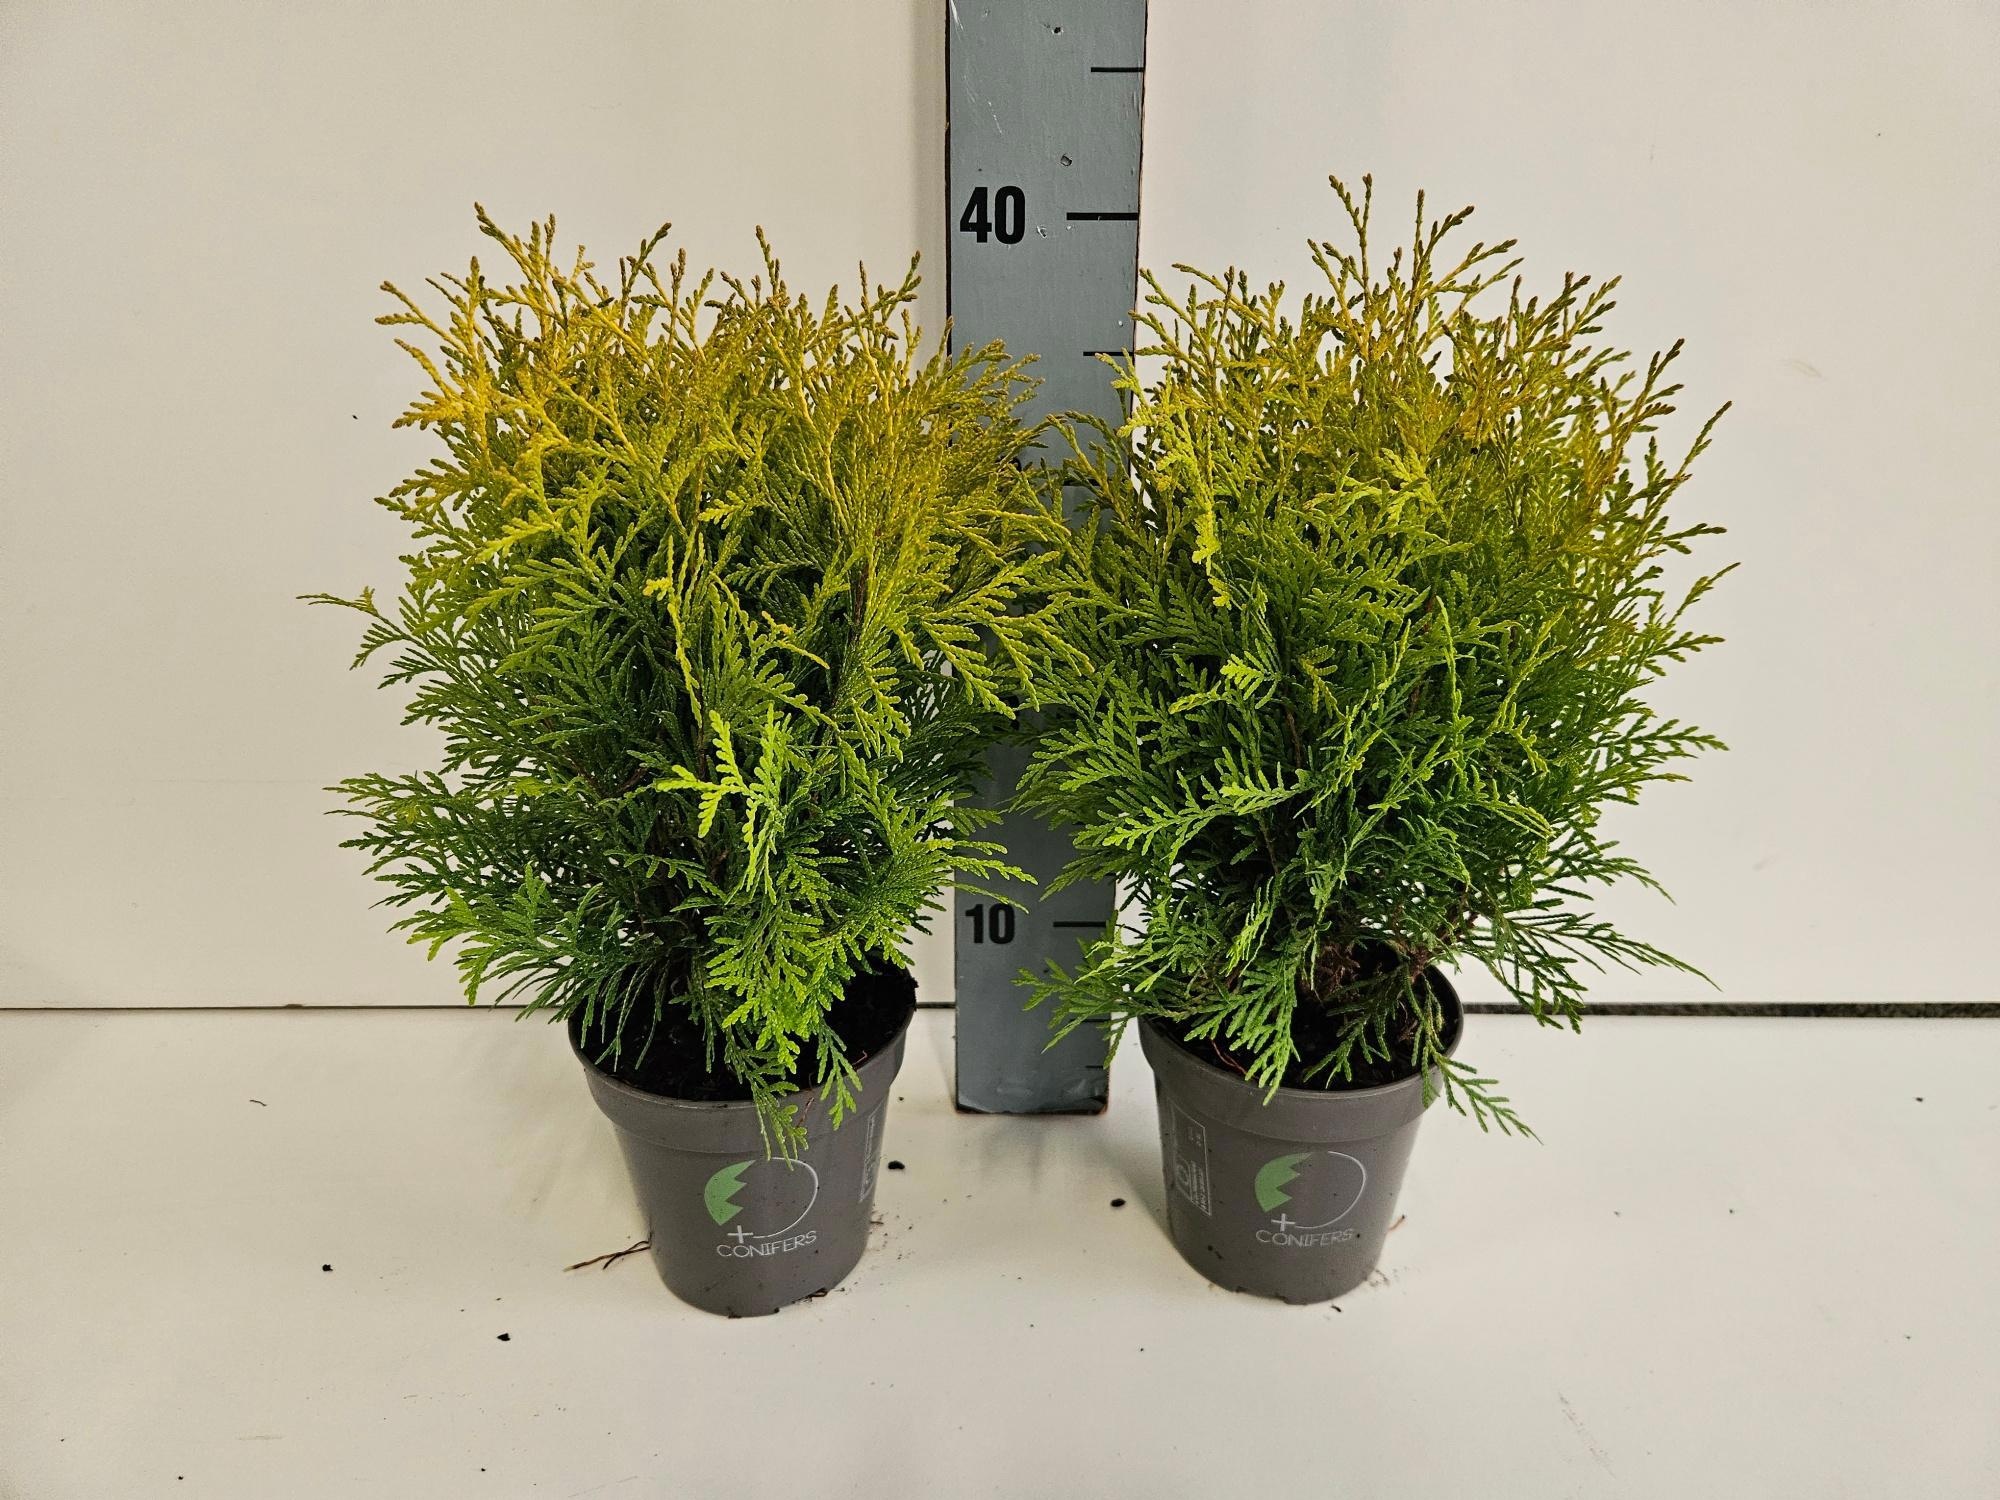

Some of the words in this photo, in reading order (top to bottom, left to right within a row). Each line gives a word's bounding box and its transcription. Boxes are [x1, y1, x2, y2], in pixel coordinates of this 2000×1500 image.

[960, 185, 1026, 245] 40
[965, 902, 1015, 945] 10
[716, 1230, 817, 1258] CONIFERS
[1255, 1228, 1354, 1247] CONIFERS
